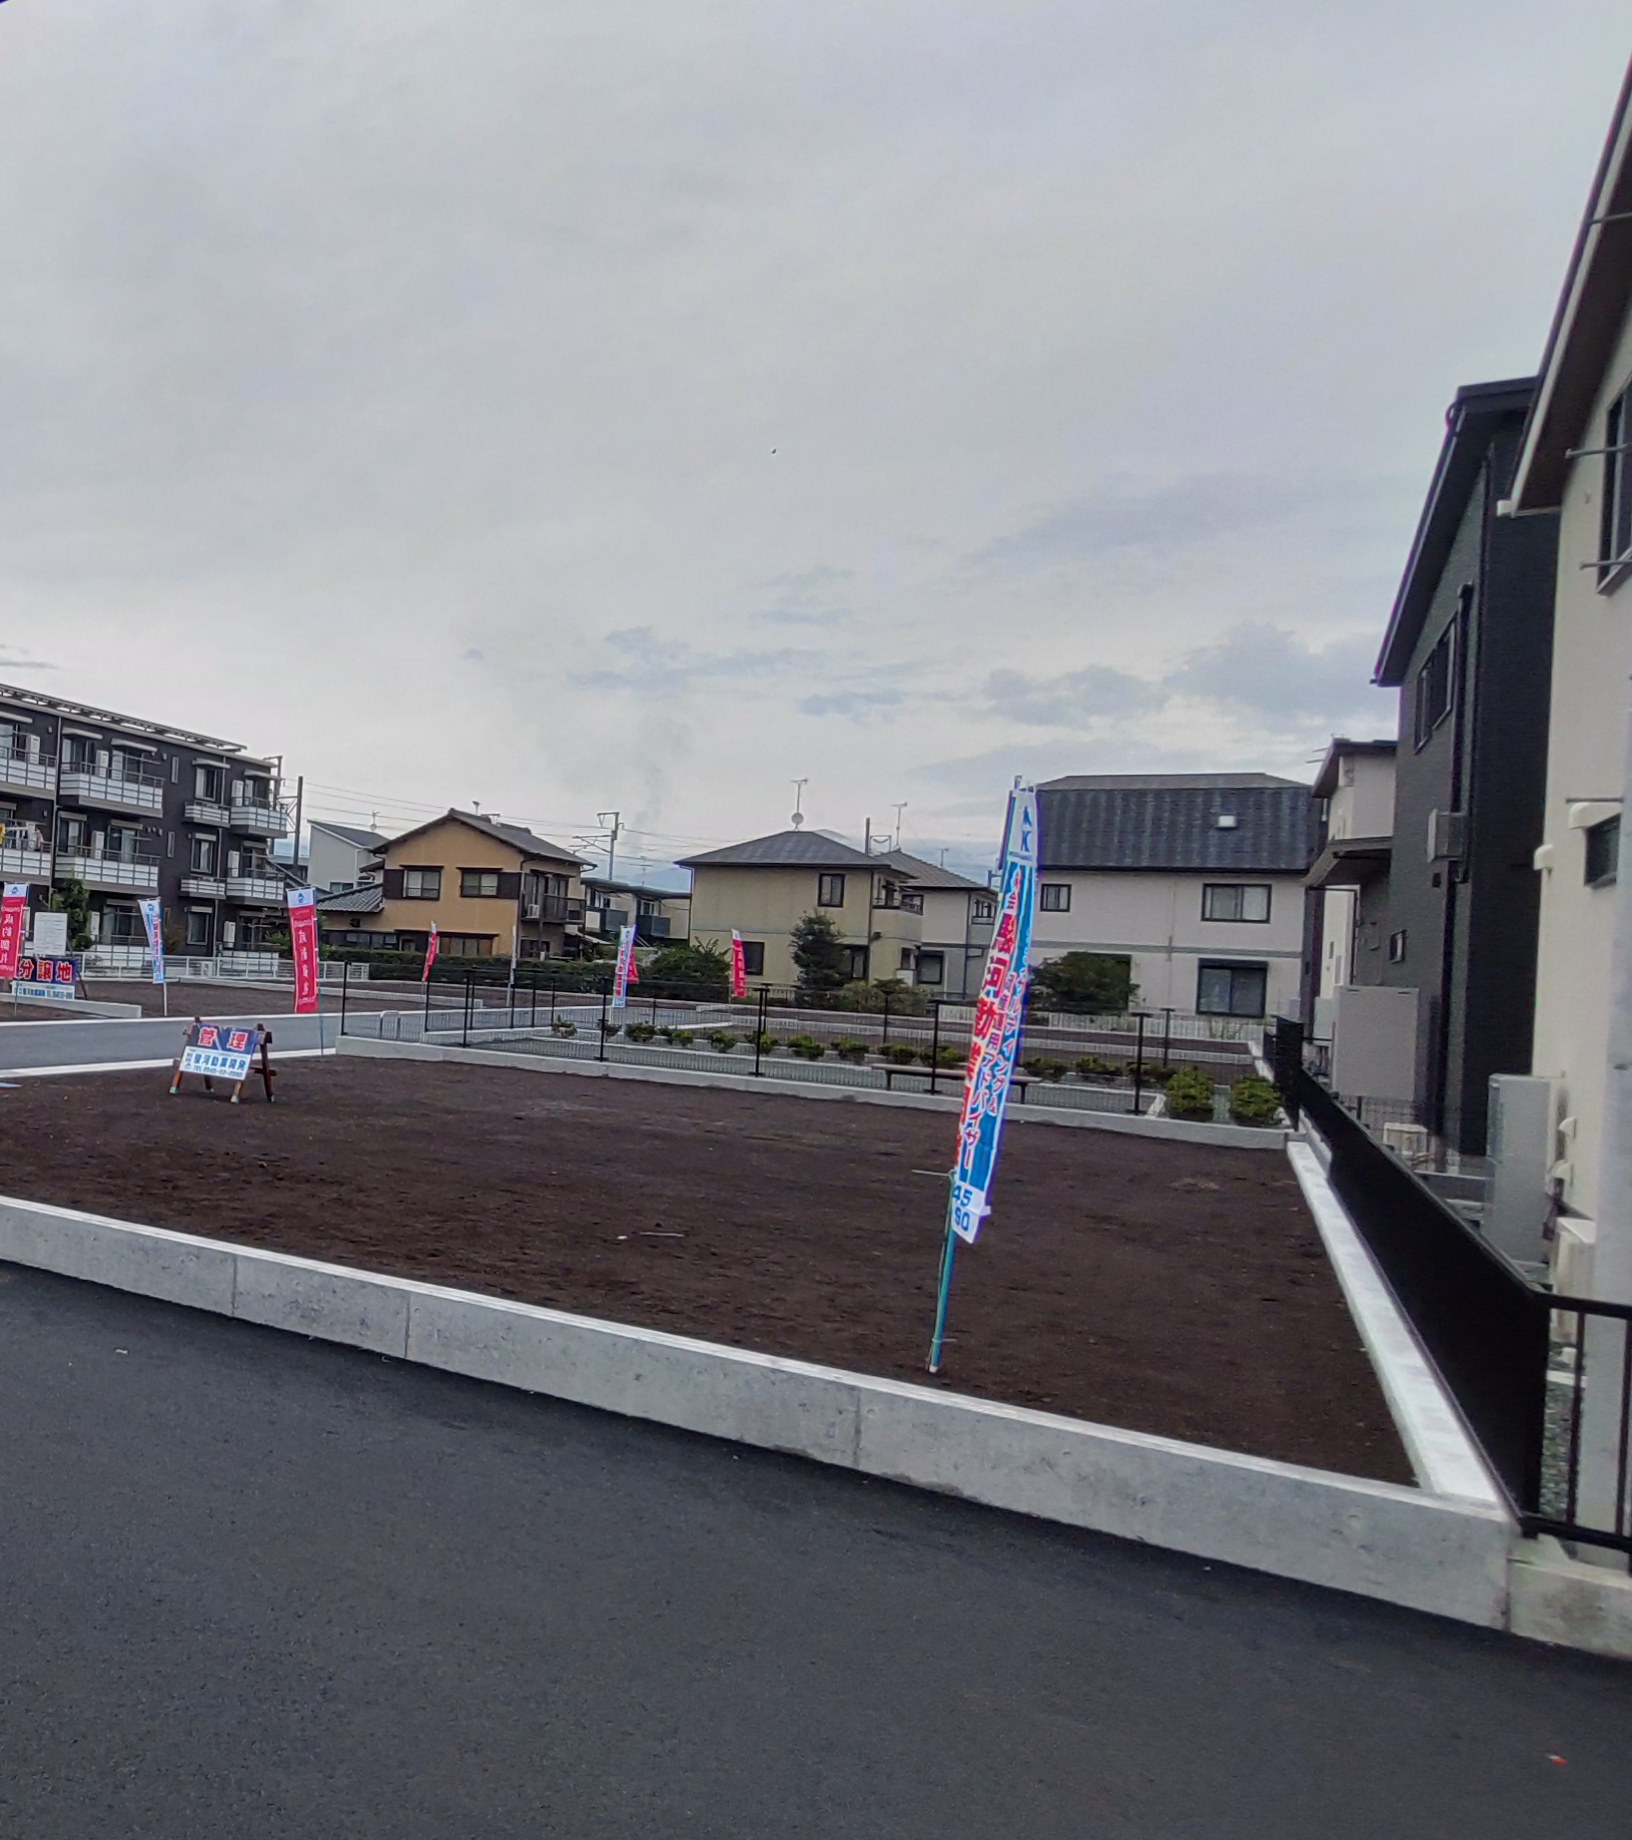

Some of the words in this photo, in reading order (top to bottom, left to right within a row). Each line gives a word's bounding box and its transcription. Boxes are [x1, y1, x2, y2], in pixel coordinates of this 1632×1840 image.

[18, 958, 73, 983] 分譲地
[198, 1027, 249, 1051] 管理
[952, 1185, 972, 1208] 45
[954, 1208, 971, 1232] 90
